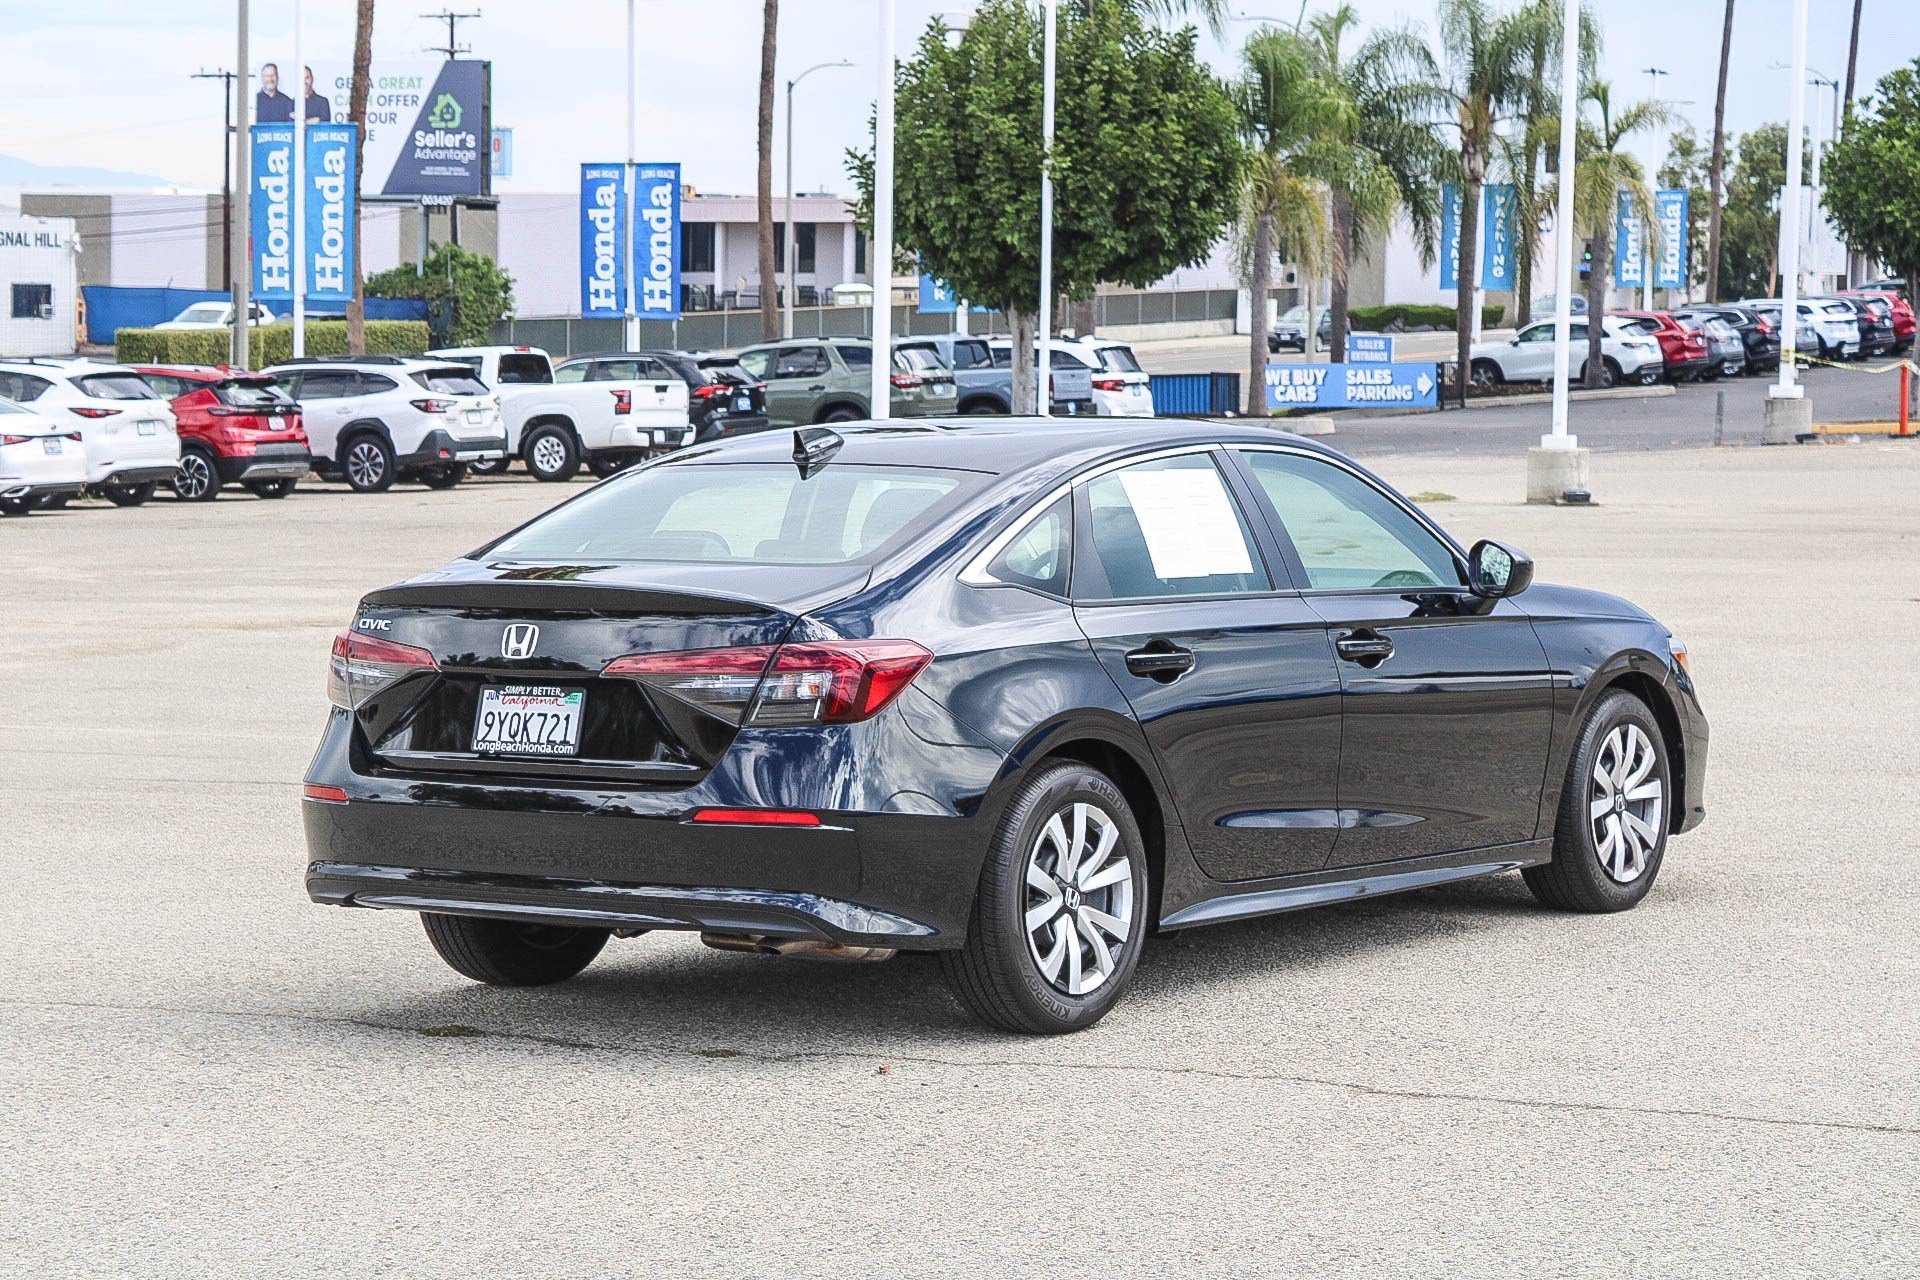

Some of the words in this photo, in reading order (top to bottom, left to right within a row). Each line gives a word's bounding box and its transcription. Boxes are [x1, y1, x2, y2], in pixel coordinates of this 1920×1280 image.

[378, 77, 424, 89] GREAT
[376, 94, 420, 107] OFFER
[364, 112, 398, 125] OUR
[414, 129, 476, 149] Seller's
[414, 148, 477, 164] Advantage
[259, 146, 290, 292] Honda
[314, 146, 346, 293] Honda
[35, 232, 62, 248] HILL
[588, 182, 617, 311] Honda
[642, 182, 673, 312] Honda
[1659, 201, 1682, 284] Honda
[1265, 368, 1290, 386] WE
[1292, 368, 1327, 386] BUY
[1346, 368, 1393, 386] SALES
[1274, 385, 1318, 403] CARS
[1346, 385, 1414, 402] PARKING
[358, 618, 393, 632] CIVIC
[485, 691, 500, 702] JUN
[504, 685, 532, 696] SIMPLY
[532, 687, 562, 697] BETTER
[501, 694, 566, 711] California
[481, 710, 572, 745] 9YQK721
[473, 740, 575, 754] LongBeachHonda.com
